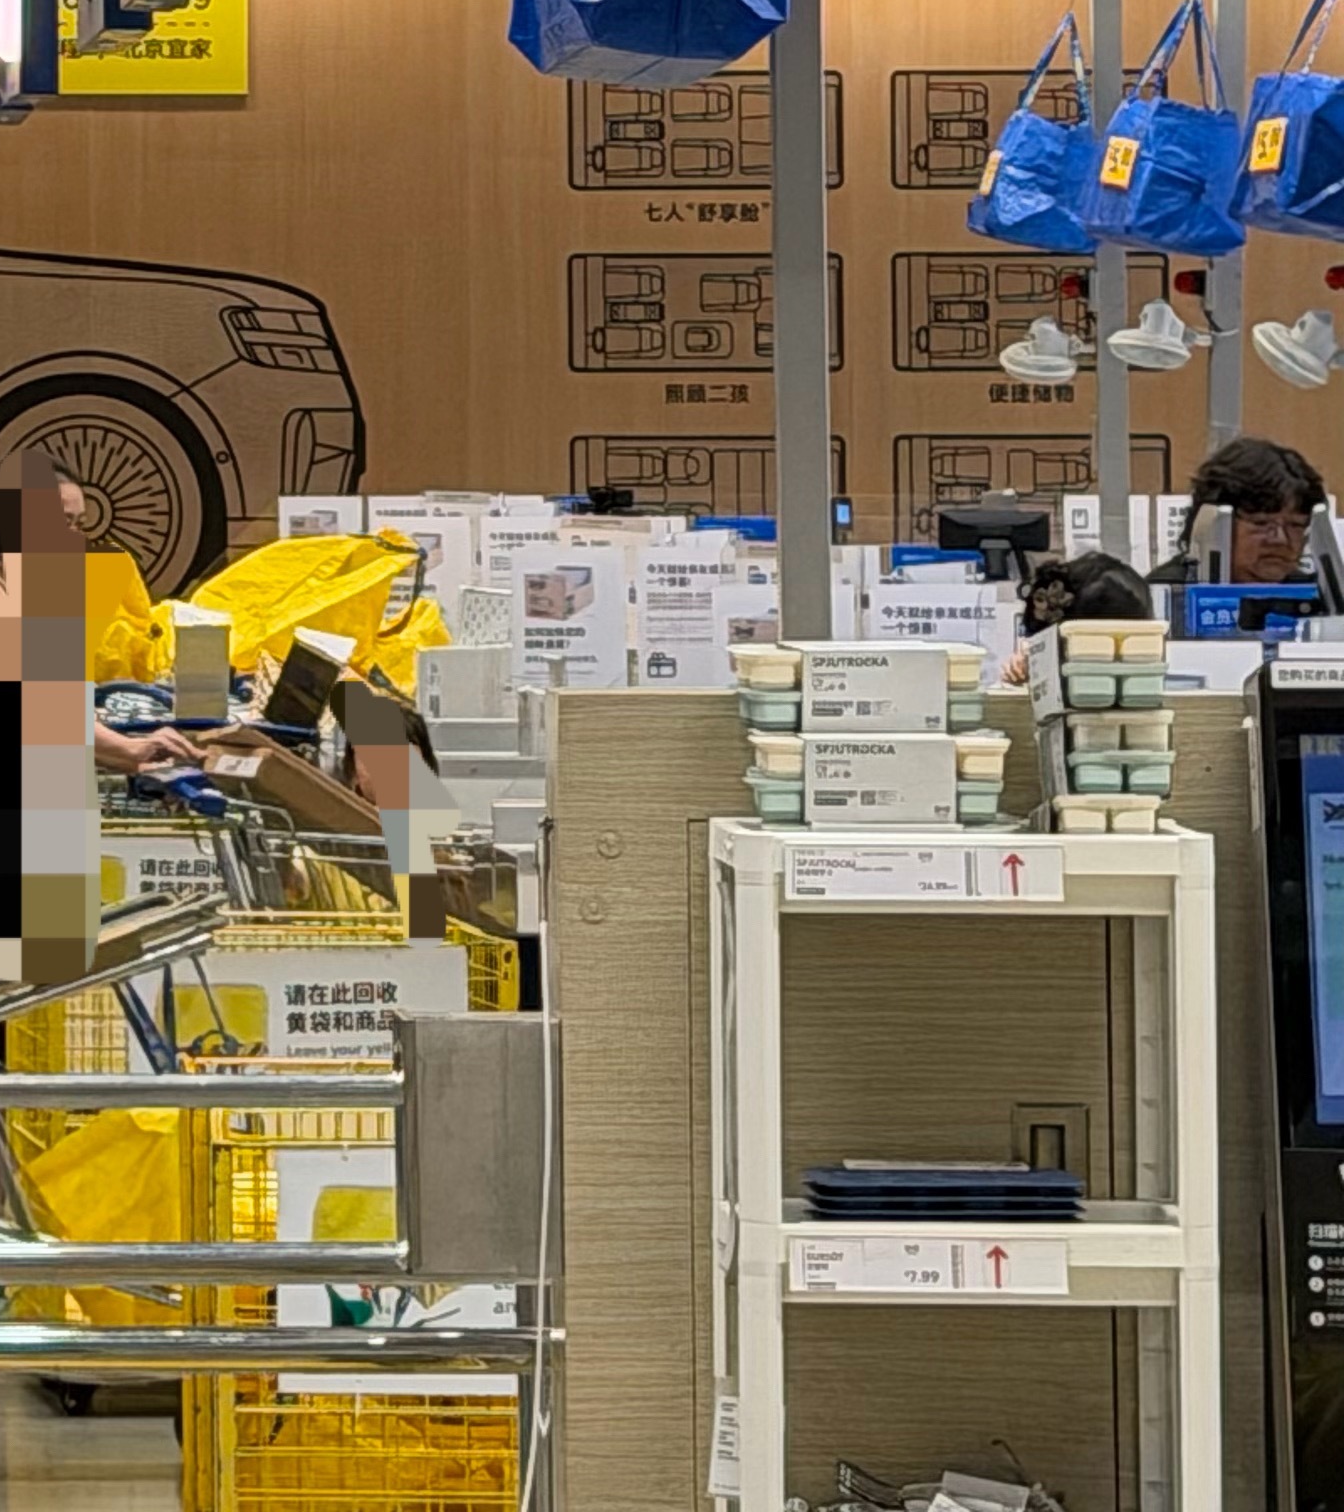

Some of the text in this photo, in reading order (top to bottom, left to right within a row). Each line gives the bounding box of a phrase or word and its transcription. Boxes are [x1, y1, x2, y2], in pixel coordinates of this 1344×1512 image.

[284, 981, 398, 1006] 请在此回收
[286, 1010, 394, 1034] 黄袋和商品
